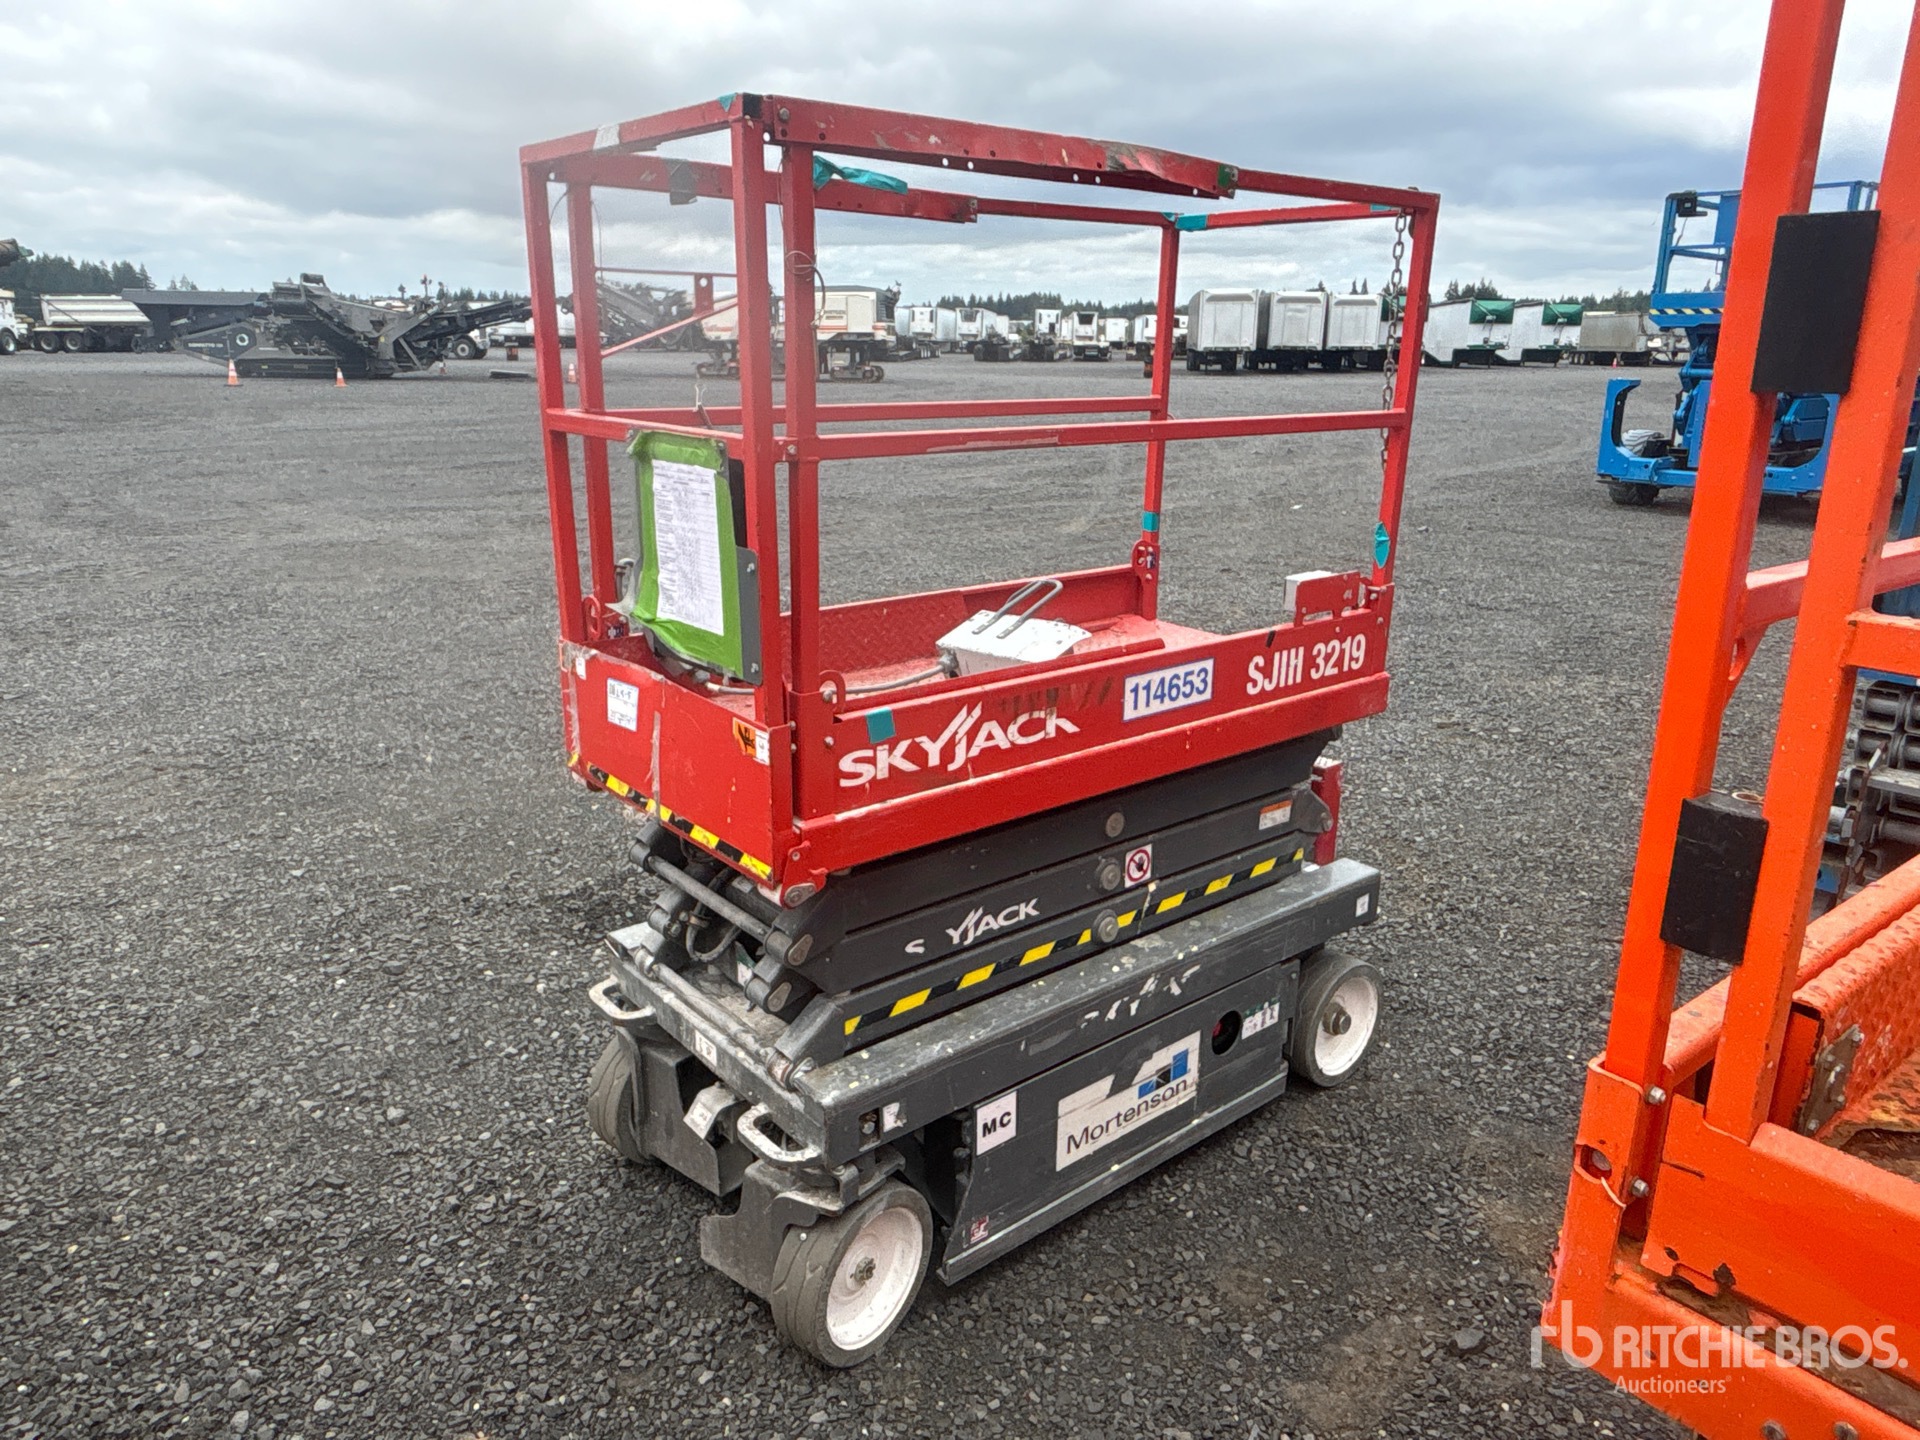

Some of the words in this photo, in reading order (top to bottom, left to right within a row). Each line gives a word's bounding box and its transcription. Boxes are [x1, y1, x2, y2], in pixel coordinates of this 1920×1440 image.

[1310, 633, 1366, 680] 3219
[1129, 667, 1209, 711] 114653
[838, 700, 1081, 788] SKYJACK
[982, 1111, 1012, 1138] MC
[1066, 1078, 1188, 1155] Mortenson
